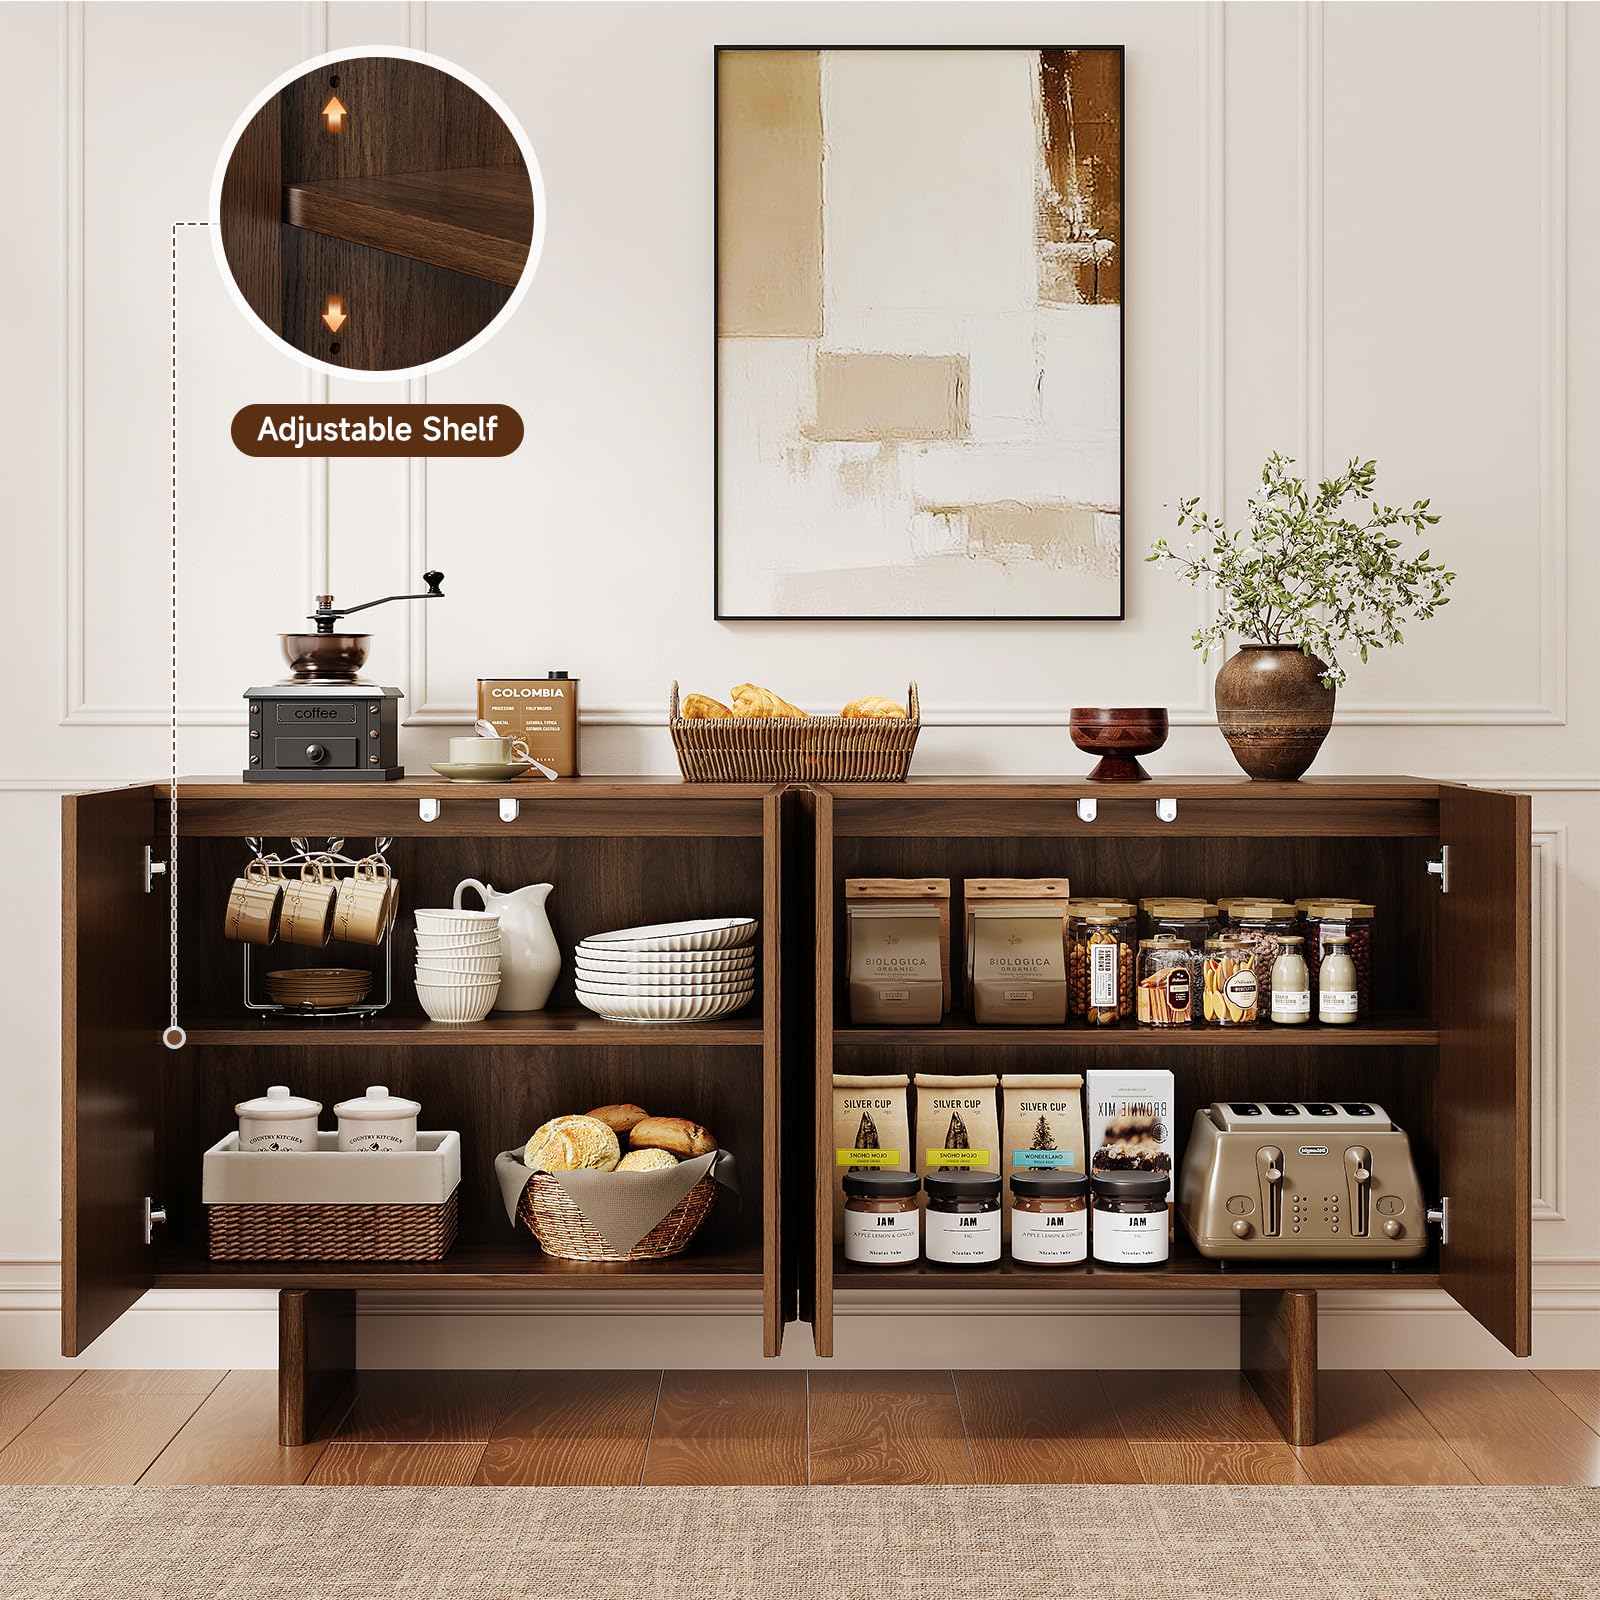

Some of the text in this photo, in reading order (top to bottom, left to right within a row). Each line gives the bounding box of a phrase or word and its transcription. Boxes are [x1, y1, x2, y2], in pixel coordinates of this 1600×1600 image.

[491, 688, 565, 698] COLOMBIA
[294, 707, 338, 719] coffee
[865, 958, 927, 966] BIOLOGICA
[989, 958, 1051, 966] BIOLOGICA
[843, 1099, 892, 1109] SILVER CUP
[933, 1099, 982, 1109] SILVER CUP
[1020, 1102, 1067, 1111] SILVER CUP
[249, 1134, 304, 1145] COUNTRY KITCHEN
[349, 1134, 404, 1145] COUNTRY KITCHEN
[876, 1217, 895, 1226] JAM
[959, 1217, 978, 1227] JAM
[1046, 1216, 1064, 1226] JAM
[1129, 1217, 1147, 1227] JAM
